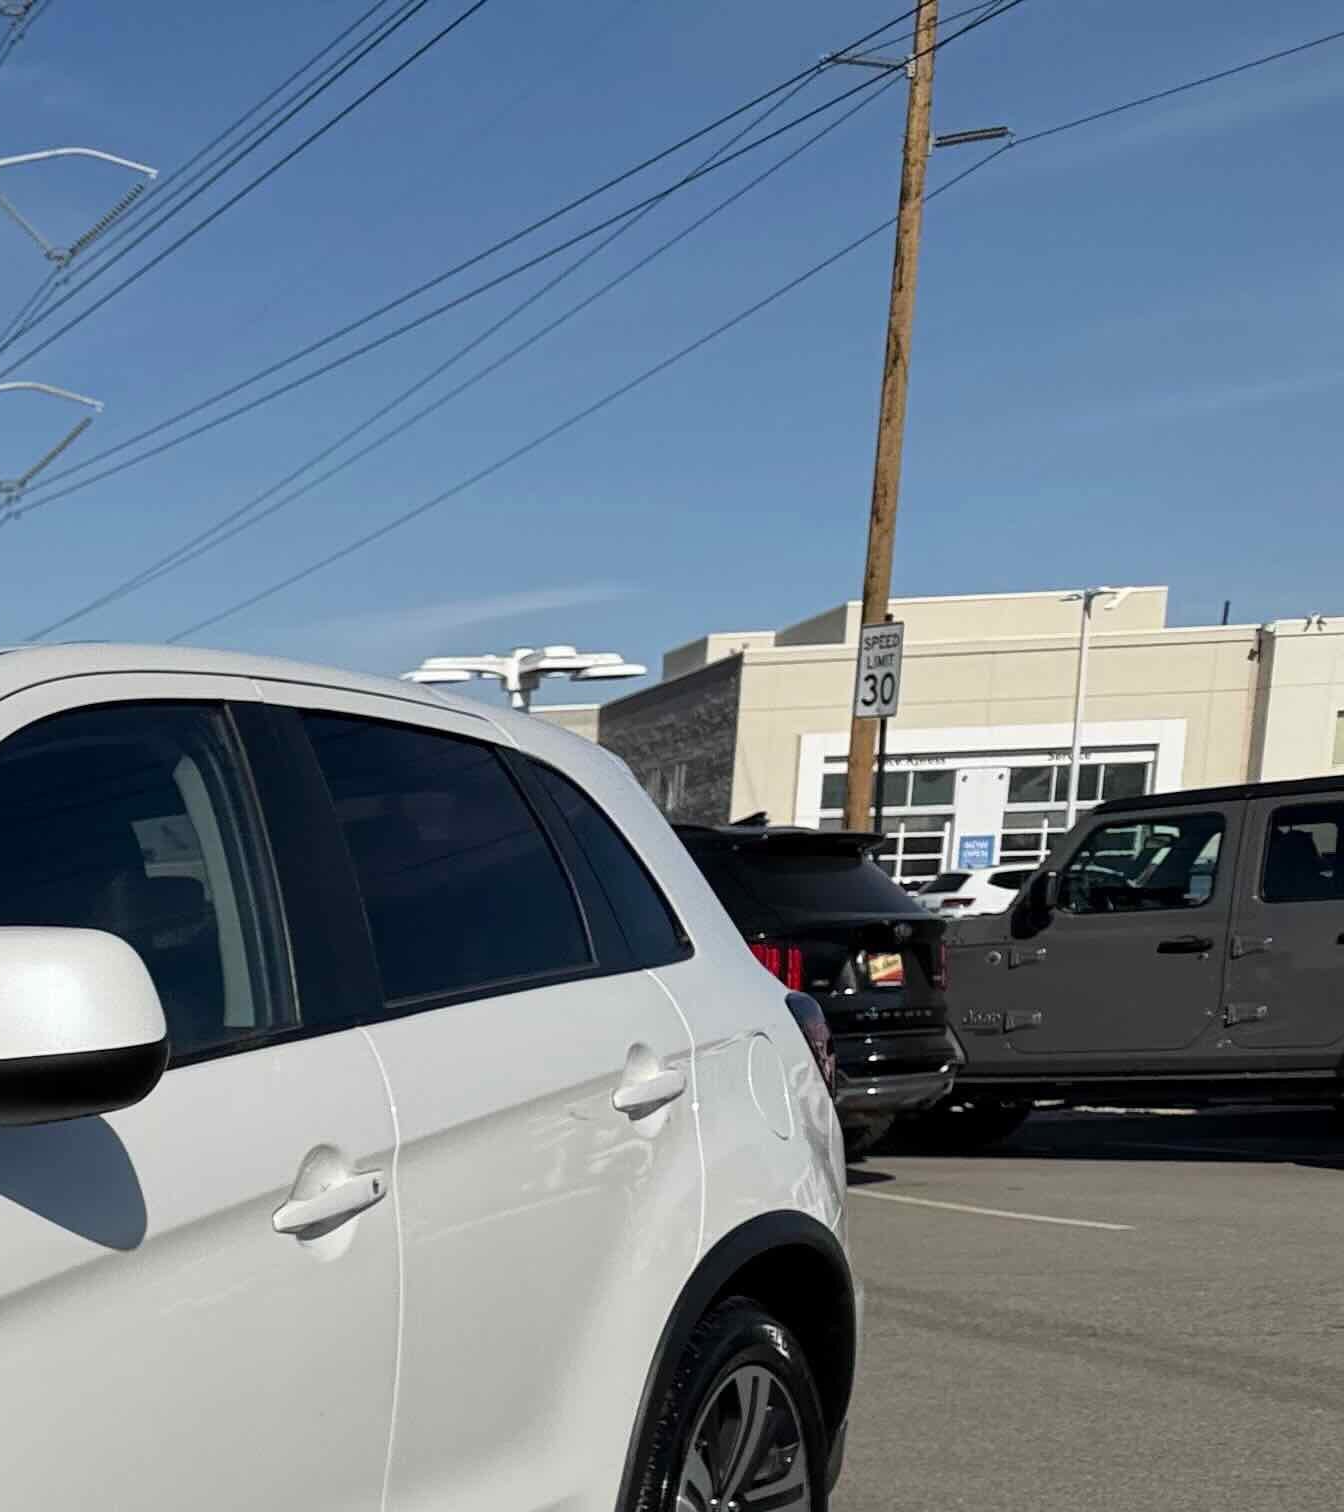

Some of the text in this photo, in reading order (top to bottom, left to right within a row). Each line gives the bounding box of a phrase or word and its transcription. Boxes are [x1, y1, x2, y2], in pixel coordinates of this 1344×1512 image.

[864, 632, 900, 651] SPEED
[866, 653, 895, 670] LIMIT
[861, 671, 896, 706] 30
